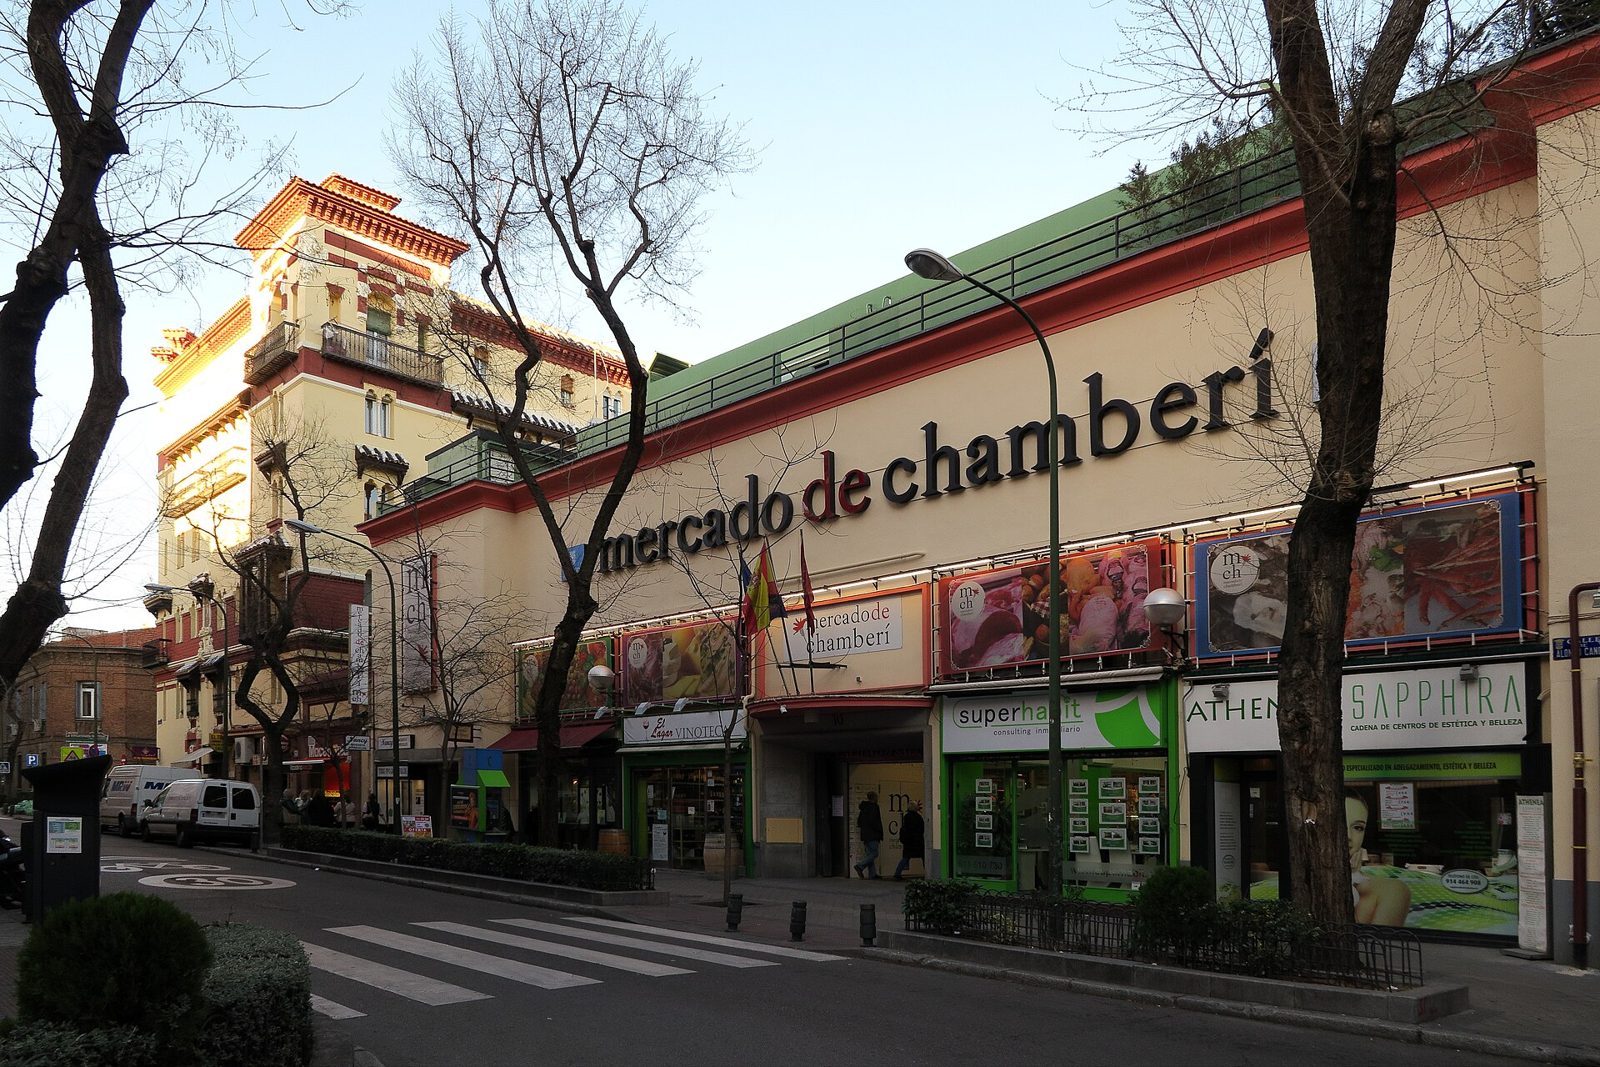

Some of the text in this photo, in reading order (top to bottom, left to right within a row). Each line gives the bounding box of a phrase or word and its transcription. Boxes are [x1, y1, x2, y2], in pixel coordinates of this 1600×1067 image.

[598, 327, 1280, 573] mercado de chamberí
[806, 623, 890, 654] chamberí
[959, 695, 1082, 728] superhait
[1187, 697, 1279, 722] ATHEN
[1352, 675, 1521, 720] SAPPHIRA
[651, 727, 673, 740] Lagar
[993, 728, 1031, 736] consulting
[1350, 724, 1378, 732] CADENA
[1392, 722, 1426, 730] CENTROS
